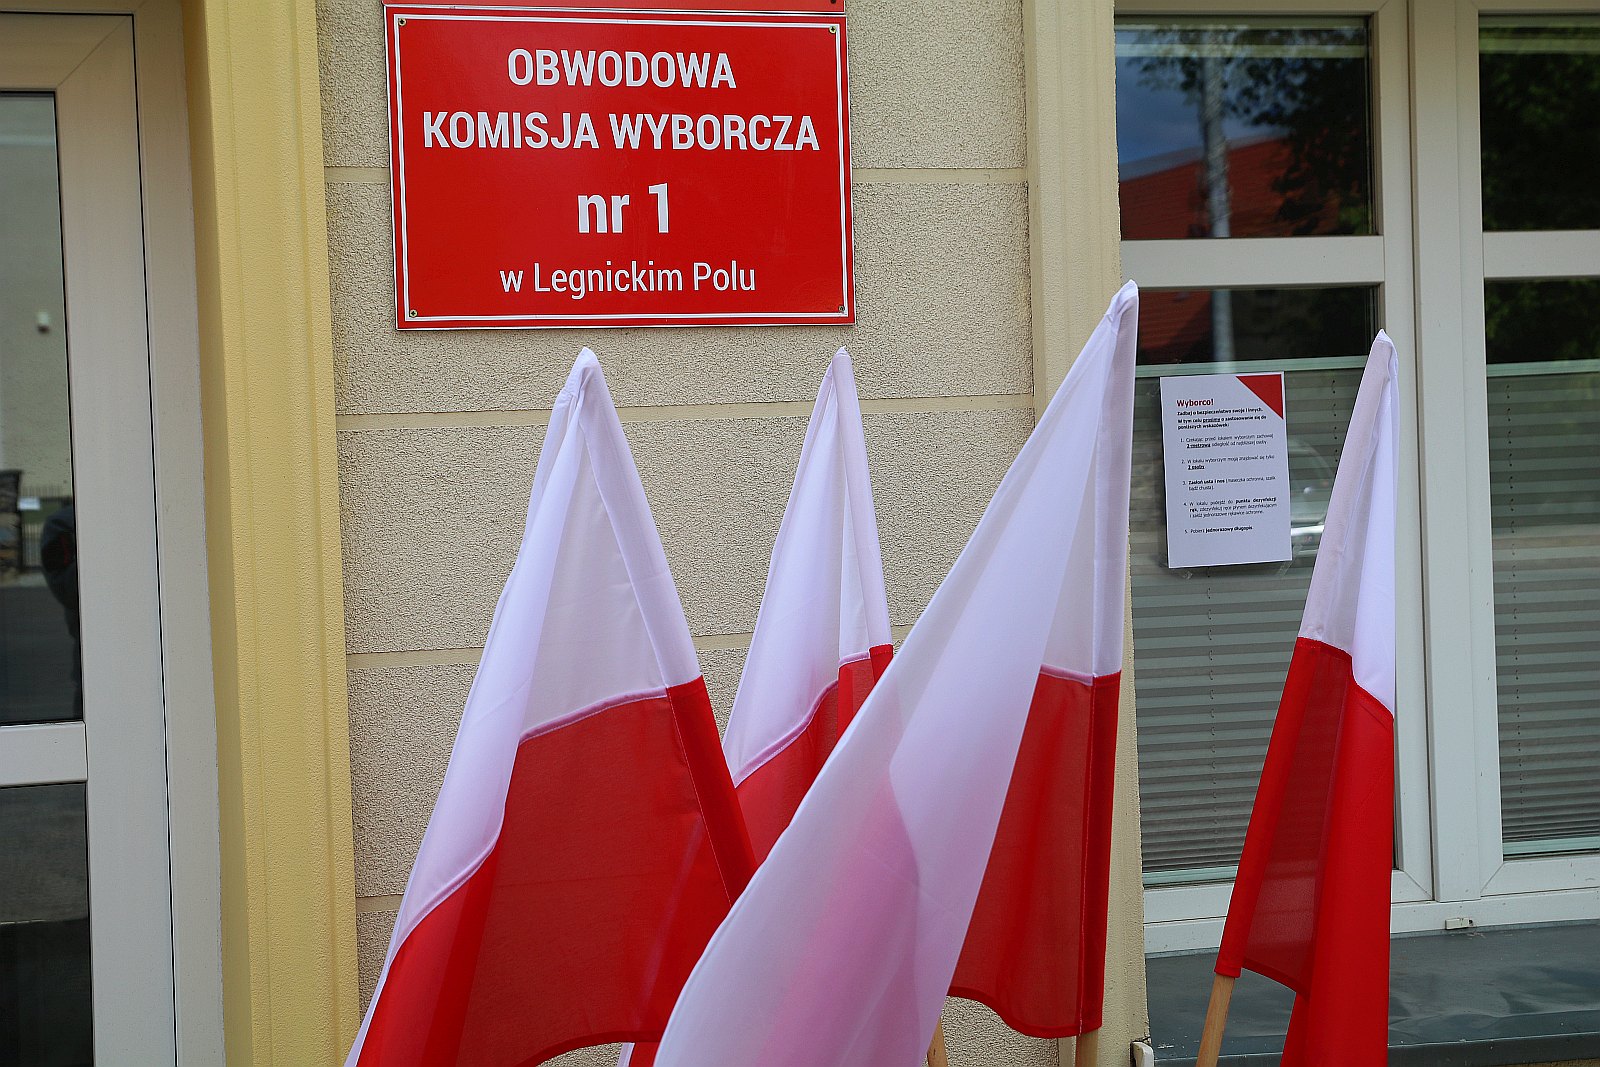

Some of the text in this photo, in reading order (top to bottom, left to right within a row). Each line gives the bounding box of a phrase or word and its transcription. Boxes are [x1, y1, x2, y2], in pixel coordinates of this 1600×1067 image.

[507, 49, 736, 88] OBWODOWA
[424, 112, 820, 150] KOMISJA WYBORCZA
[578, 183, 669, 233] nr 1
[500, 261, 755, 299] w Legnickim Polu
[1176, 398, 1214, 408] Wyborco!
